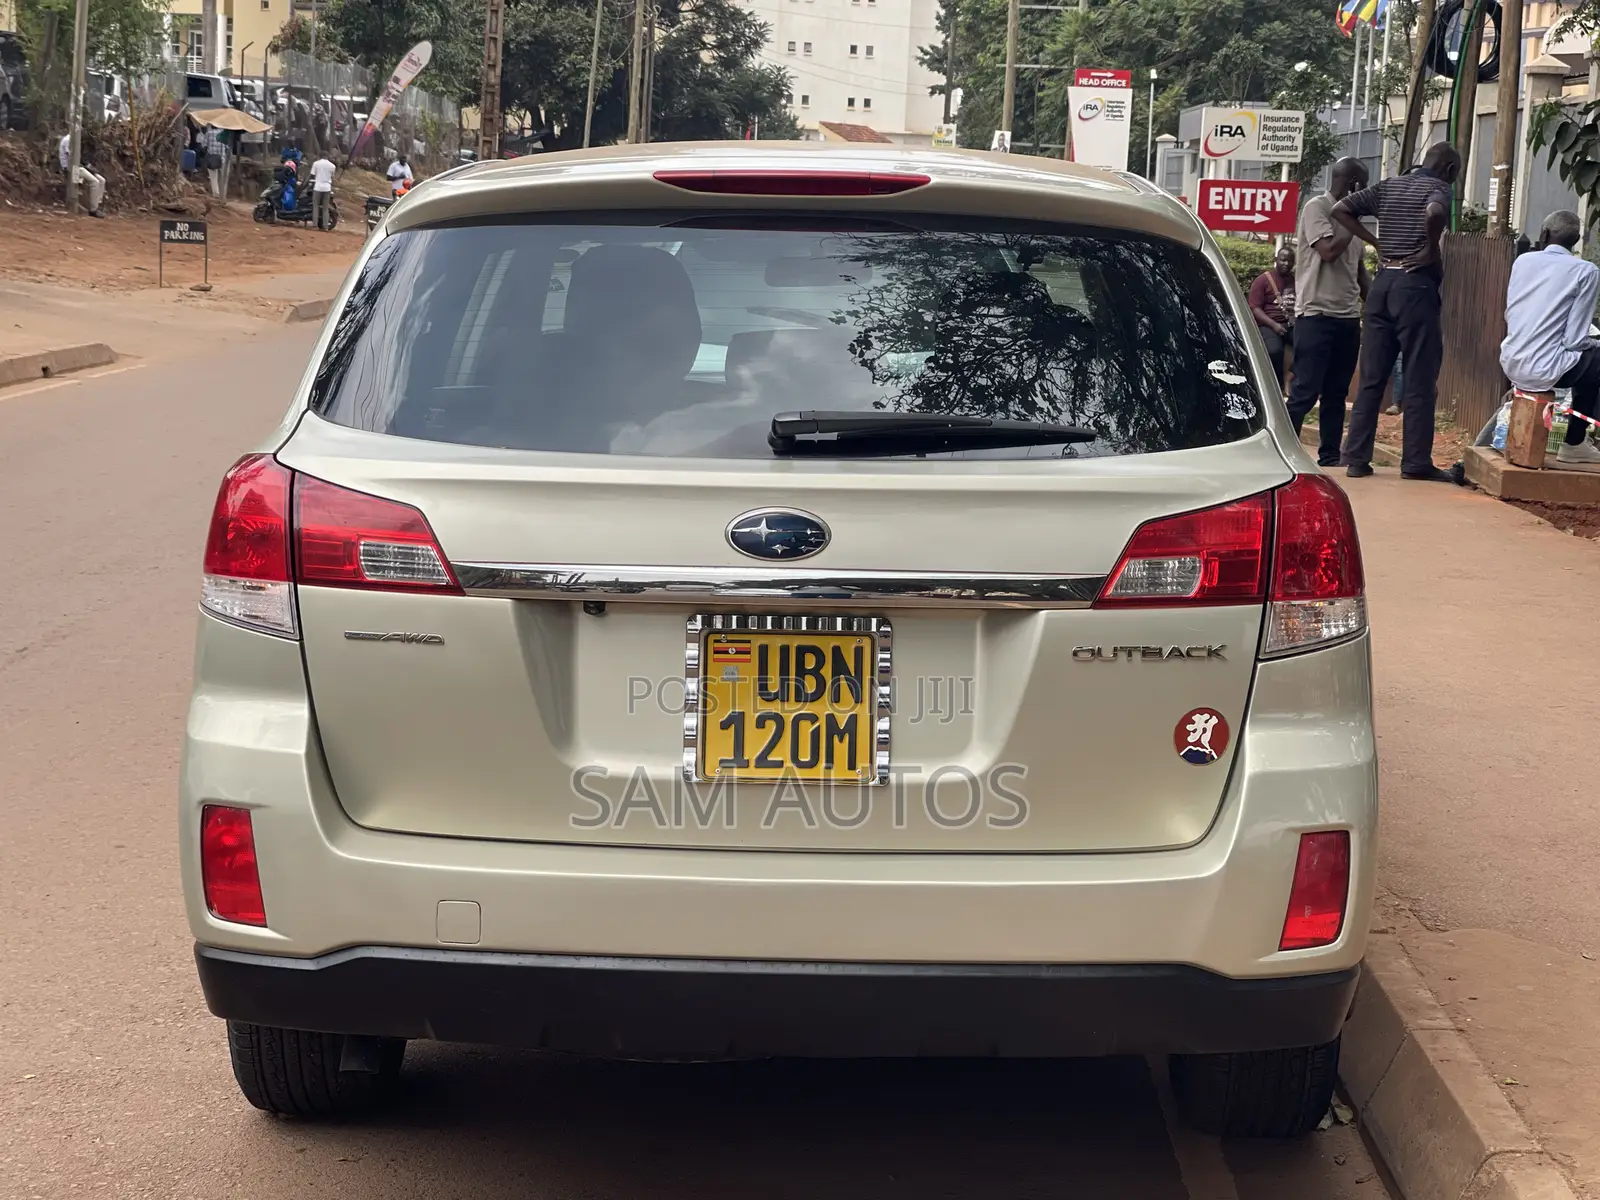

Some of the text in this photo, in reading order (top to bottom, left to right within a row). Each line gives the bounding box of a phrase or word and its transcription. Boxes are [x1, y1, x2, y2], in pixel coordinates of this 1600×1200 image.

[1101, 79, 1127, 87] OFFICE
[1263, 115, 1300, 123] Insurance
[1262, 124, 1302, 134] Regulatory
[1262, 134, 1296, 143] Authority
[1270, 144, 1298, 152] Uganda
[1208, 187, 1288, 212] ENTRY
[176, 222, 189, 231] NO
[164, 230, 205, 240] PARKING
[381, 631, 445, 645] AWD
[1072, 644, 1228, 661] OUTBACK
[757, 643, 864, 705] UBN
[718, 711, 858, 771] 120M
